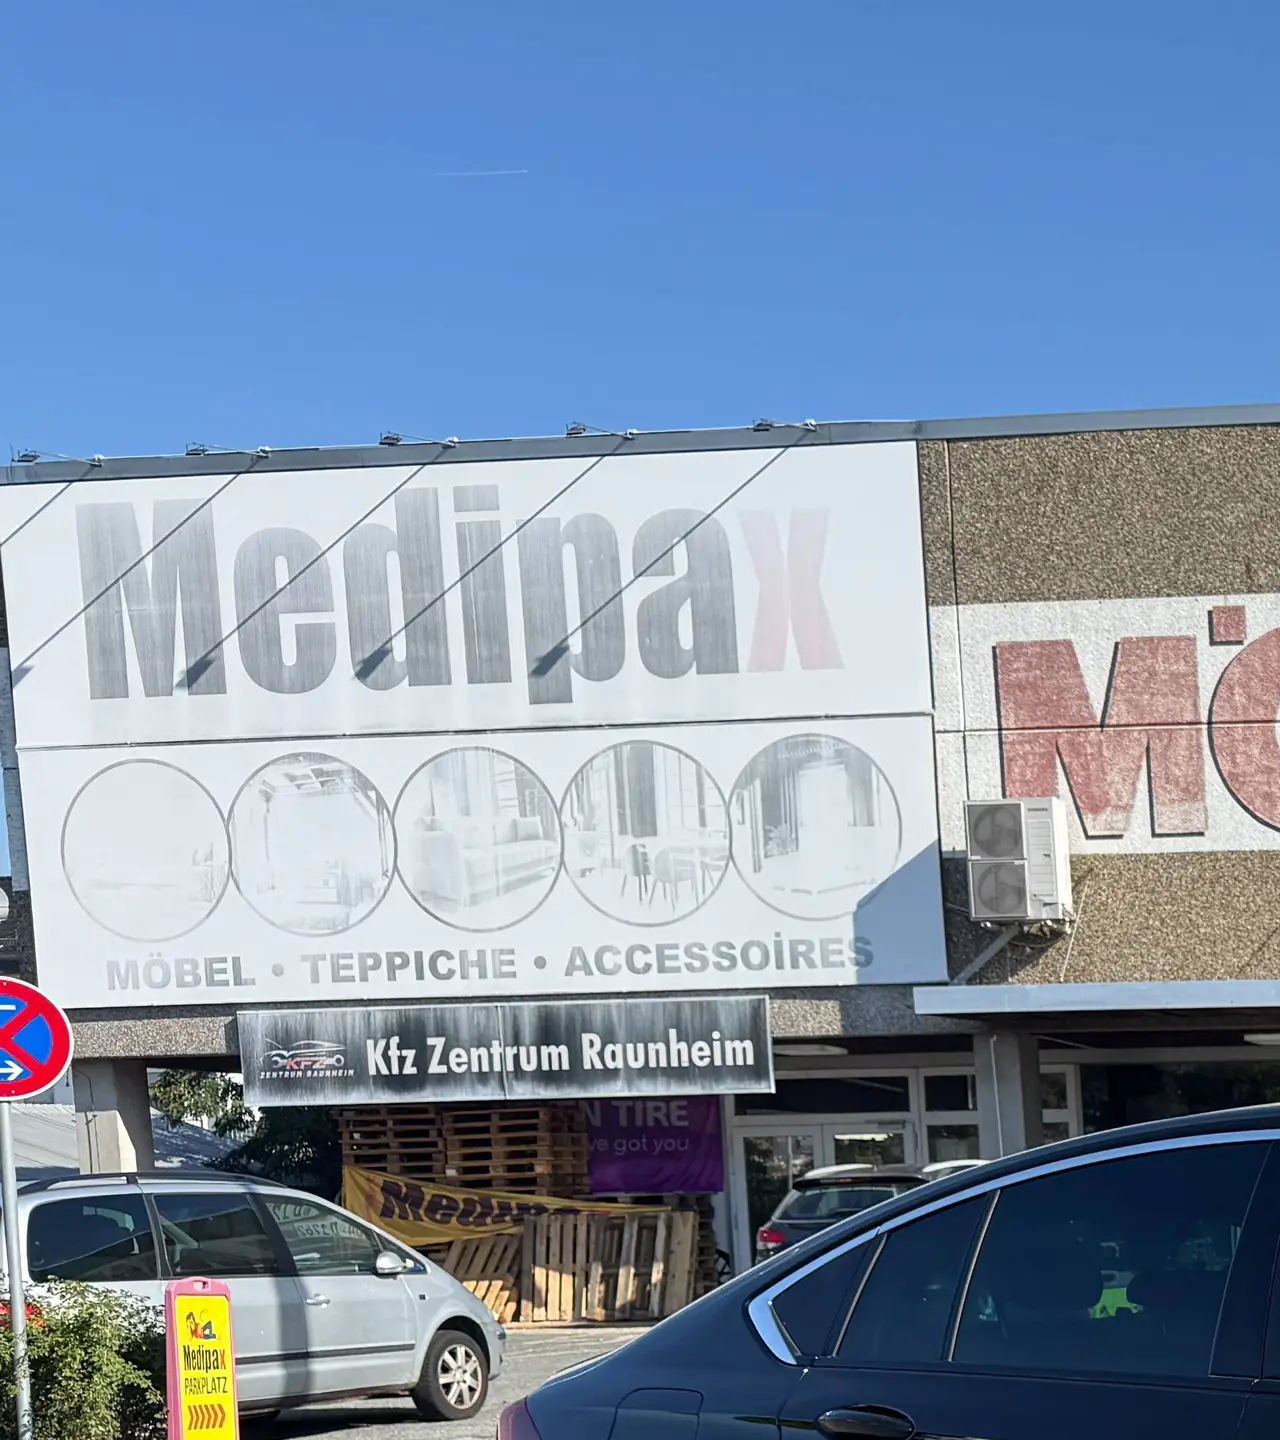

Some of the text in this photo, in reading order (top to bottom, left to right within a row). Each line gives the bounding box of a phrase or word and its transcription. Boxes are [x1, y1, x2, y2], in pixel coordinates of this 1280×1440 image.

[74, 484, 846, 705] Medipax
[105, 952, 256, 991] MÖBEL
[301, 948, 517, 985] TEPPICHE
[366, 1028, 755, 1076] Kfz Zentrum Raunheim
[612, 1100, 689, 1128] TIRE
[614, 1133, 649, 1156] got
[652, 1137, 689, 1155] you
[183, 1344, 227, 1374] Medipax
[184, 1375, 228, 1396] PARKPLATZ
